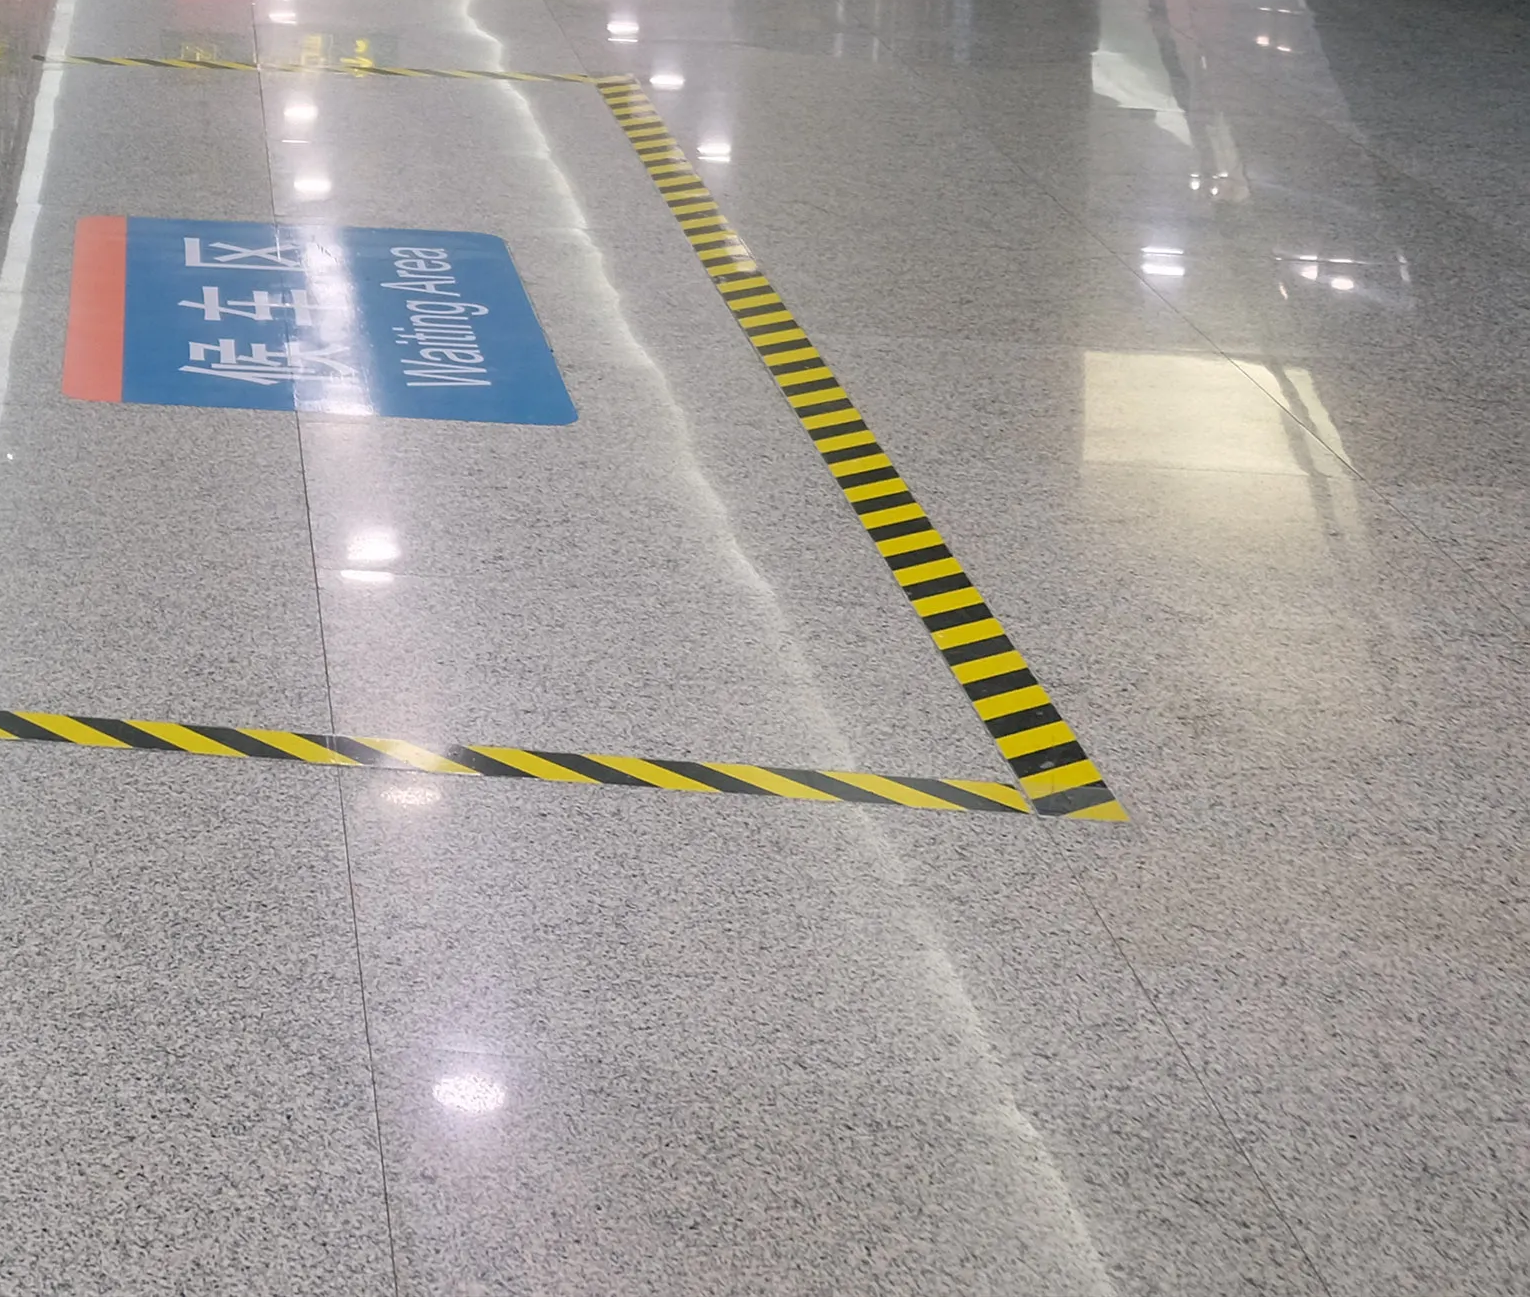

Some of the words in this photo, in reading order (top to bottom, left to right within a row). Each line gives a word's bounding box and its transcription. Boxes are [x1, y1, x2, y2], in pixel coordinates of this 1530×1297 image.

[178, 237, 359, 385] 候车区
[380, 246, 461, 297] Area
[392, 300, 491, 386] Waiting
